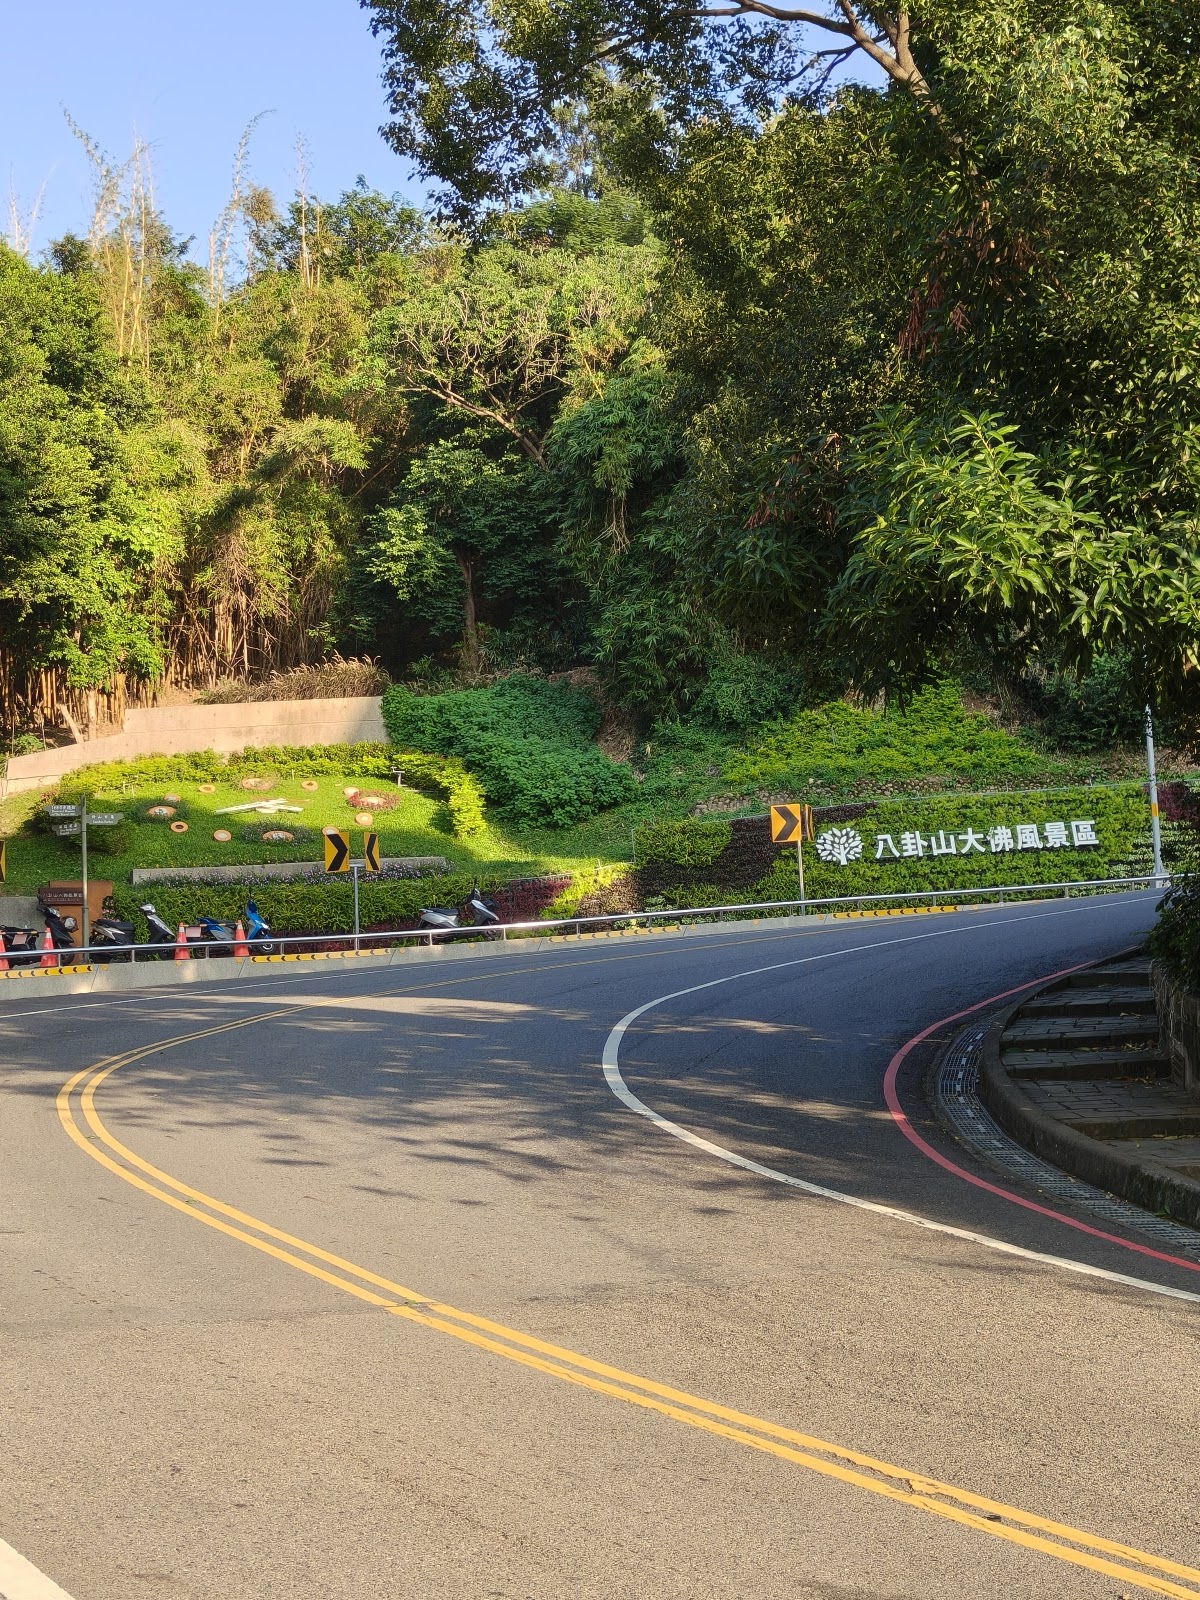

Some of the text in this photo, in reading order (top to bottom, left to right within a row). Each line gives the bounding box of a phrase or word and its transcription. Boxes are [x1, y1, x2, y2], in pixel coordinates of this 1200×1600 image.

[874, 819, 1099, 860] 八卦山大佛風景區
